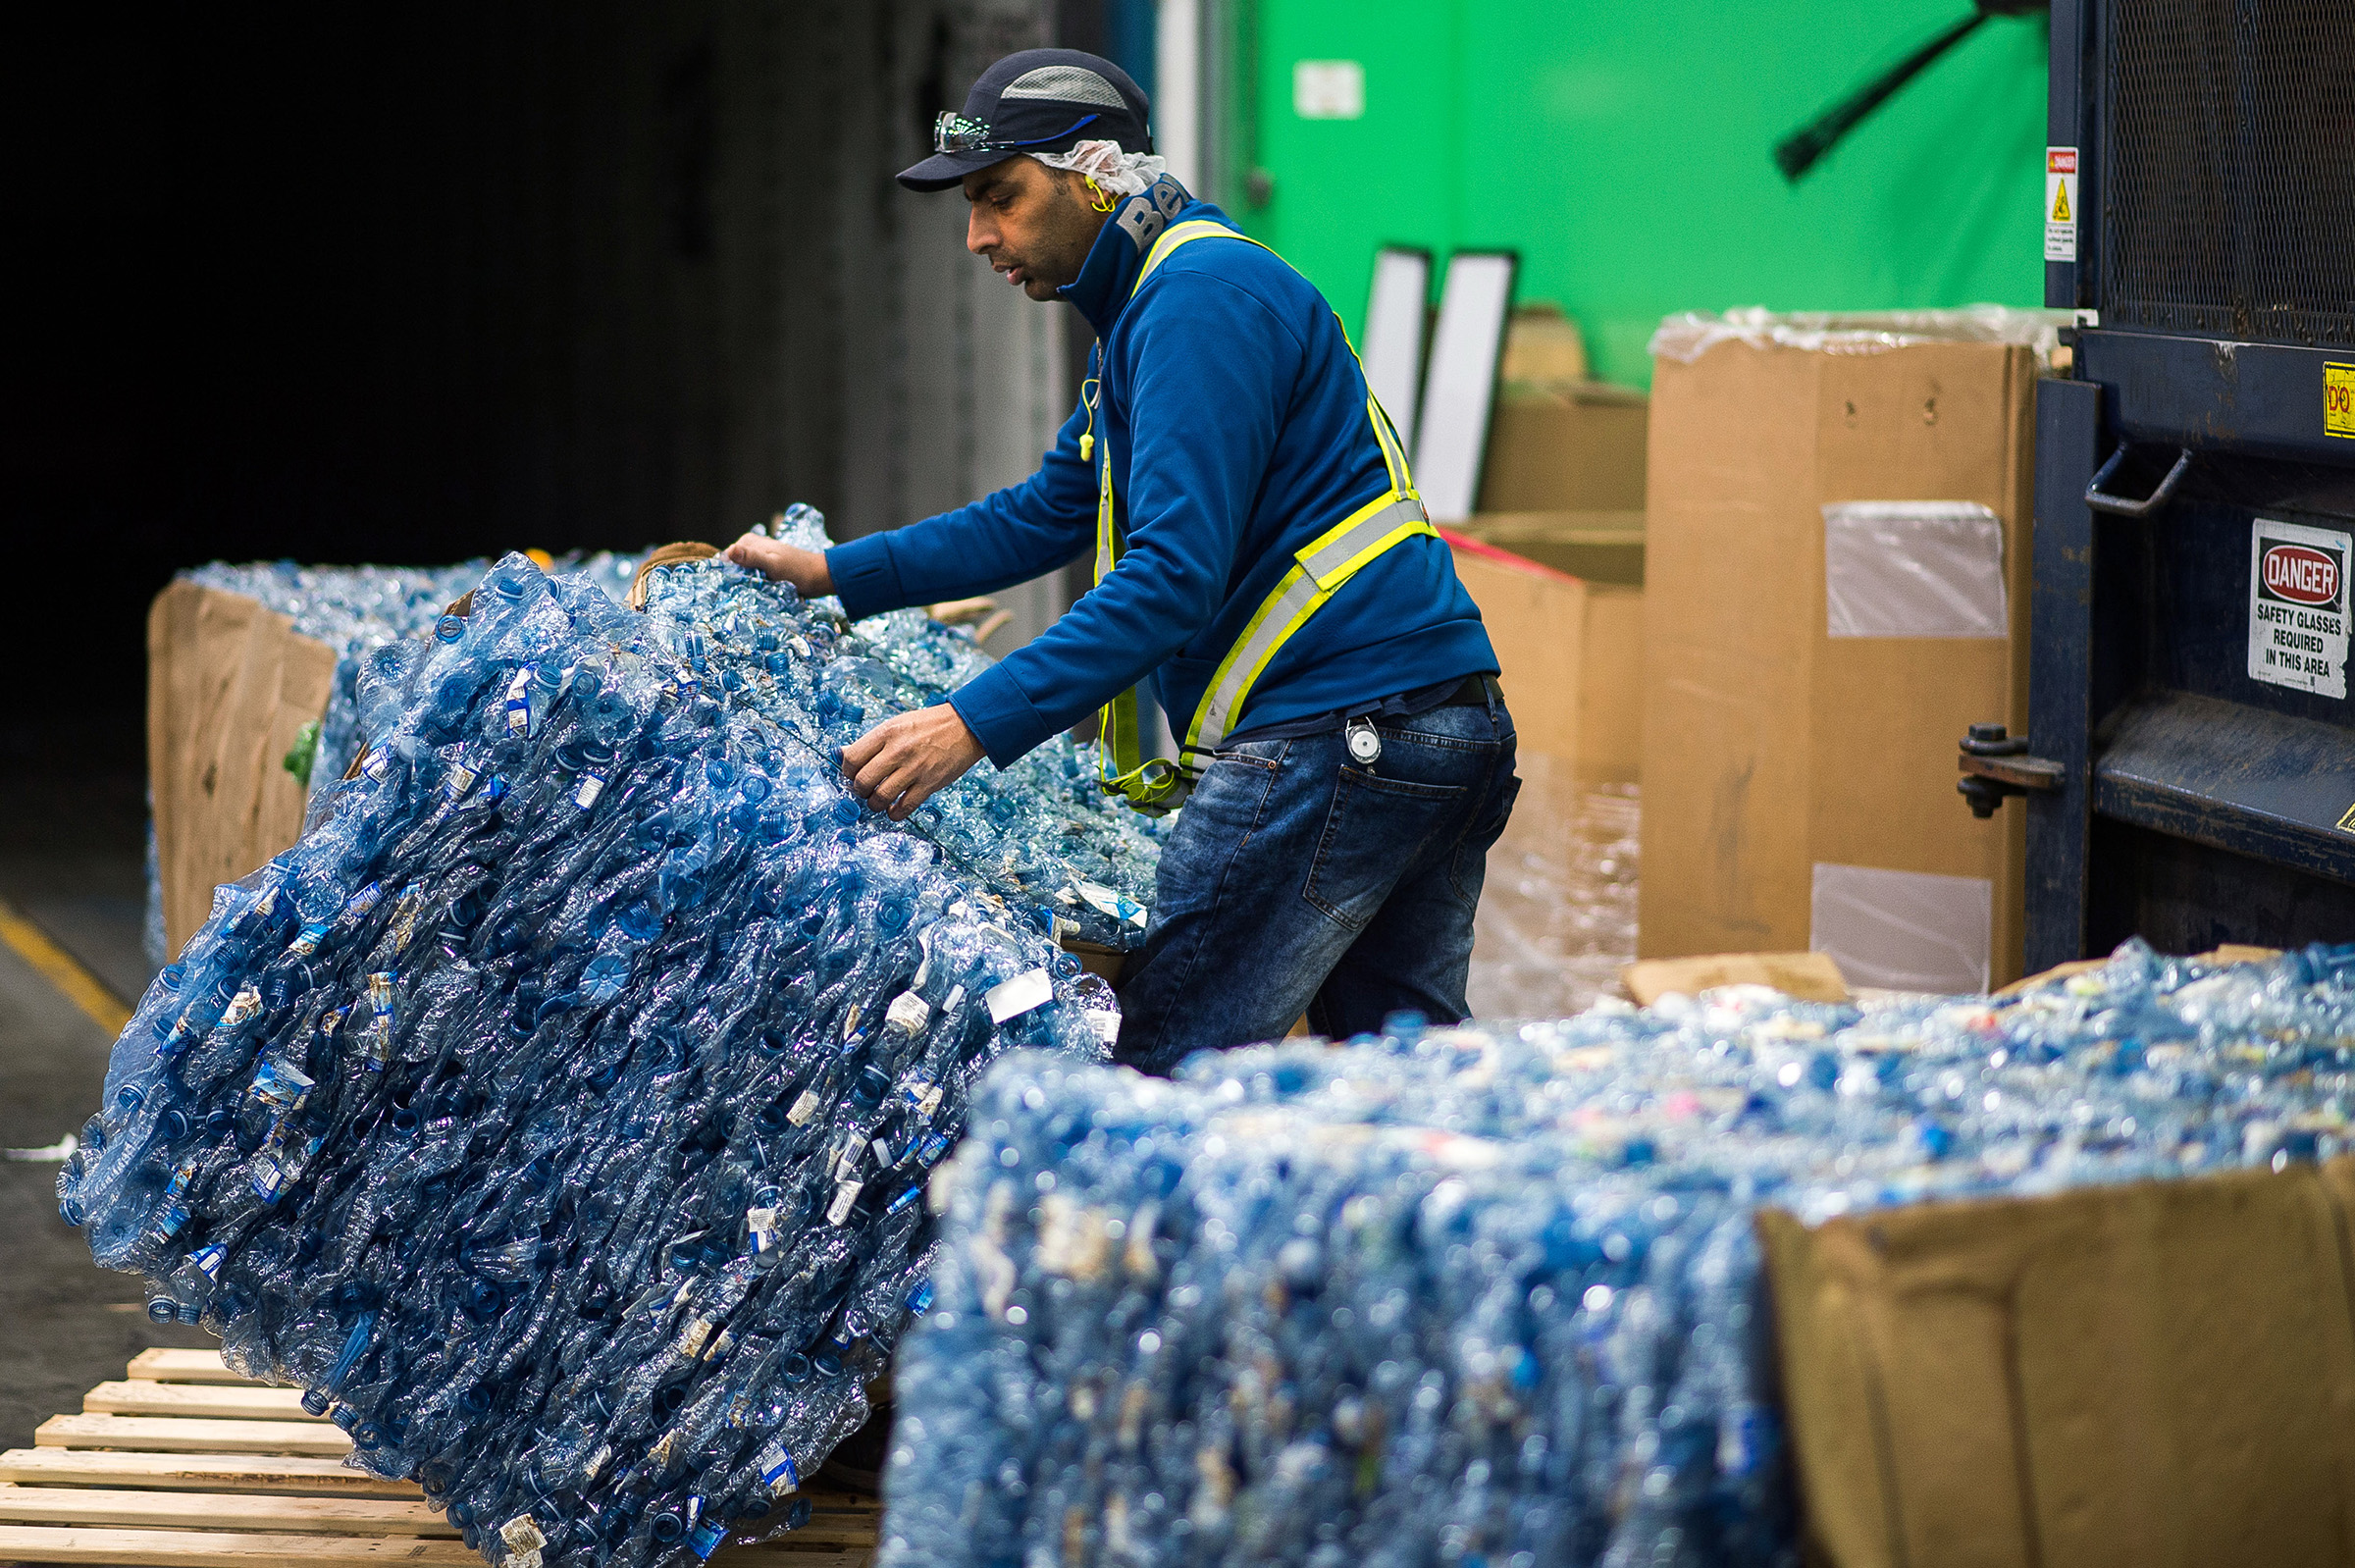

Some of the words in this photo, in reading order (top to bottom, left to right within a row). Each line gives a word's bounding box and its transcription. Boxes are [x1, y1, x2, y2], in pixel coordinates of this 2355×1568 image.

[2268, 553, 2334, 597] DANGER
[2258, 603, 2295, 626] SAFETY
[2297, 610, 2341, 636] GLASSES
[2274, 628, 2324, 653] REQUIRED
[2266, 648, 2276, 665] IN
[2278, 651, 2301, 671] THIS
[2304, 656, 2330, 678] AREA
